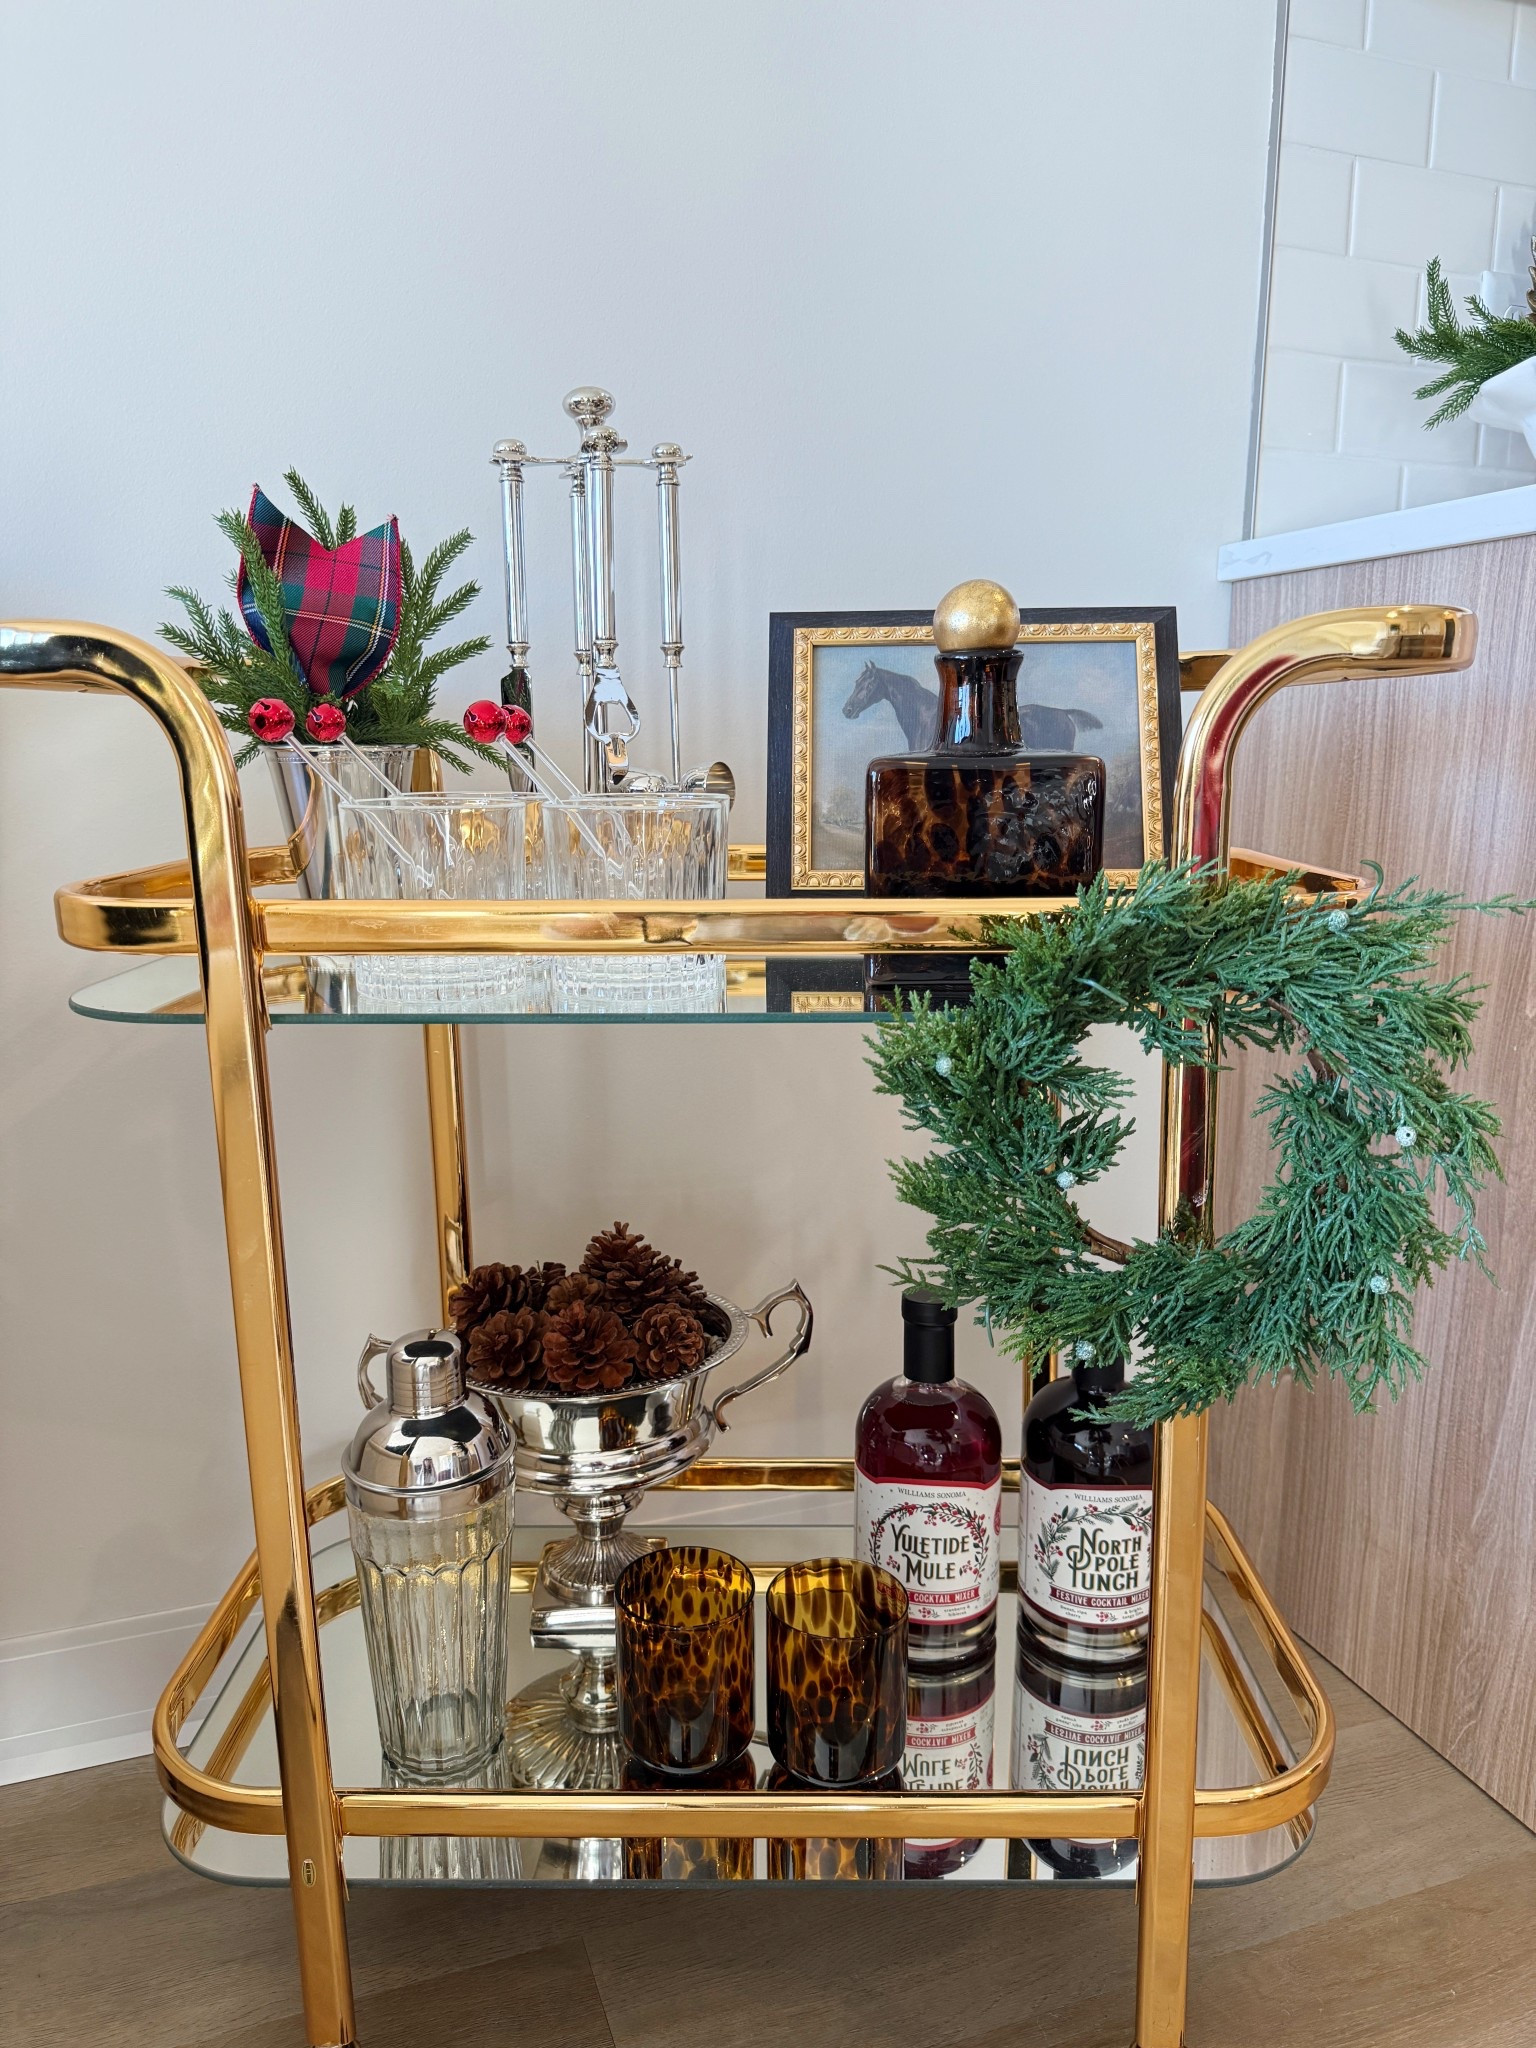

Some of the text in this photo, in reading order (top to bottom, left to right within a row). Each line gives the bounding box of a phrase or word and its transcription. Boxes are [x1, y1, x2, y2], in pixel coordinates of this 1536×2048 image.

[898, 1486, 967, 1500] WILLIAMS SONOMA
[1074, 1492, 1143, 1503] WILLIAMS SONOMA
[890, 1522, 970, 1559] YULETIDE
[1080, 1527, 1143, 1557] NORTH
[901, 1553, 956, 1587] MULE
[1066, 1544, 1139, 1592] PUNCH
[1094, 1554, 1139, 1573] POLE
[913, 1593, 952, 1603] COCKTAIL
[954, 1589, 975, 1602] MIXER
[1056, 1589, 1150, 1607] FESTIVE COCKTAIL MIXER
